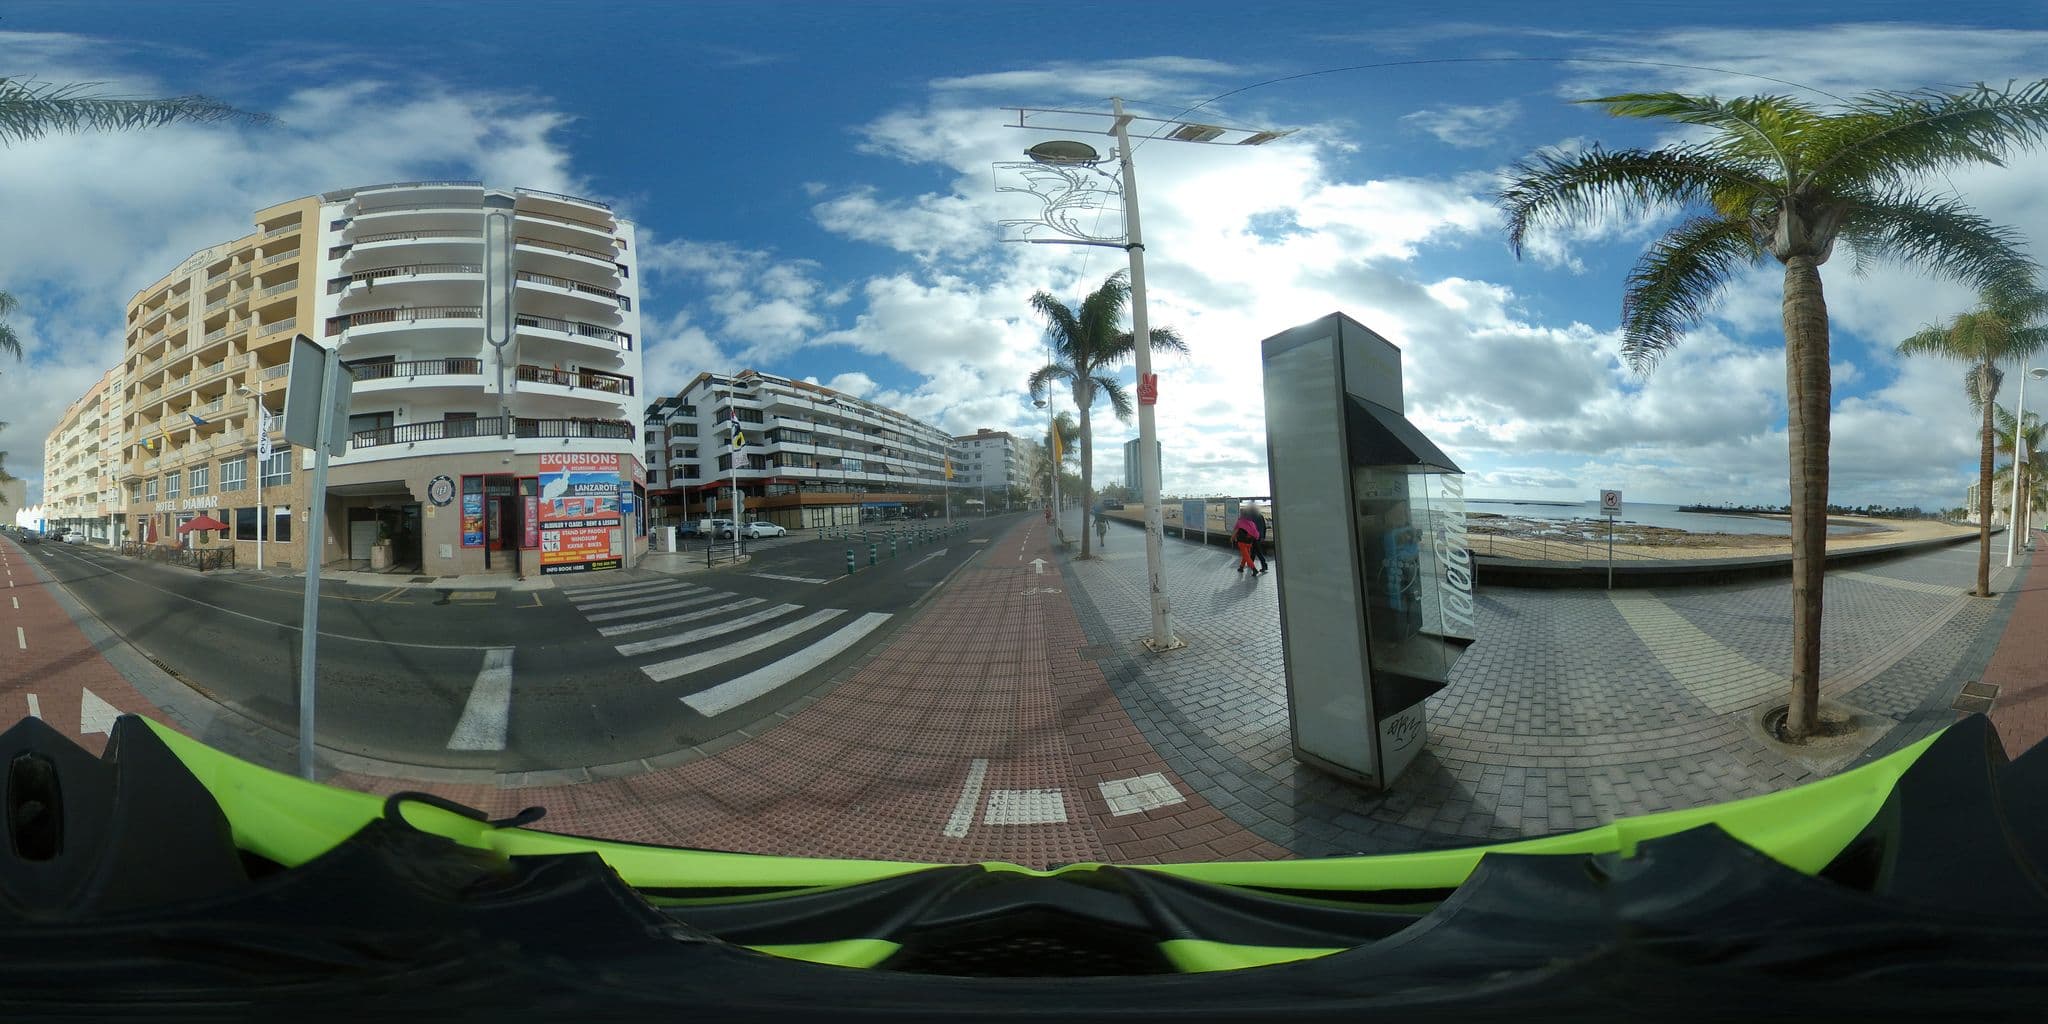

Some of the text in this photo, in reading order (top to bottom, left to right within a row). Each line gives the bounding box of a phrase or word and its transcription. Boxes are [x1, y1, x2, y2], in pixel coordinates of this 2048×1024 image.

[541, 454, 617, 465] EXCURSIONS
[574, 484, 618, 492] LANZAROTE
[155, 496, 218, 512] HOTEL DIAMAR
